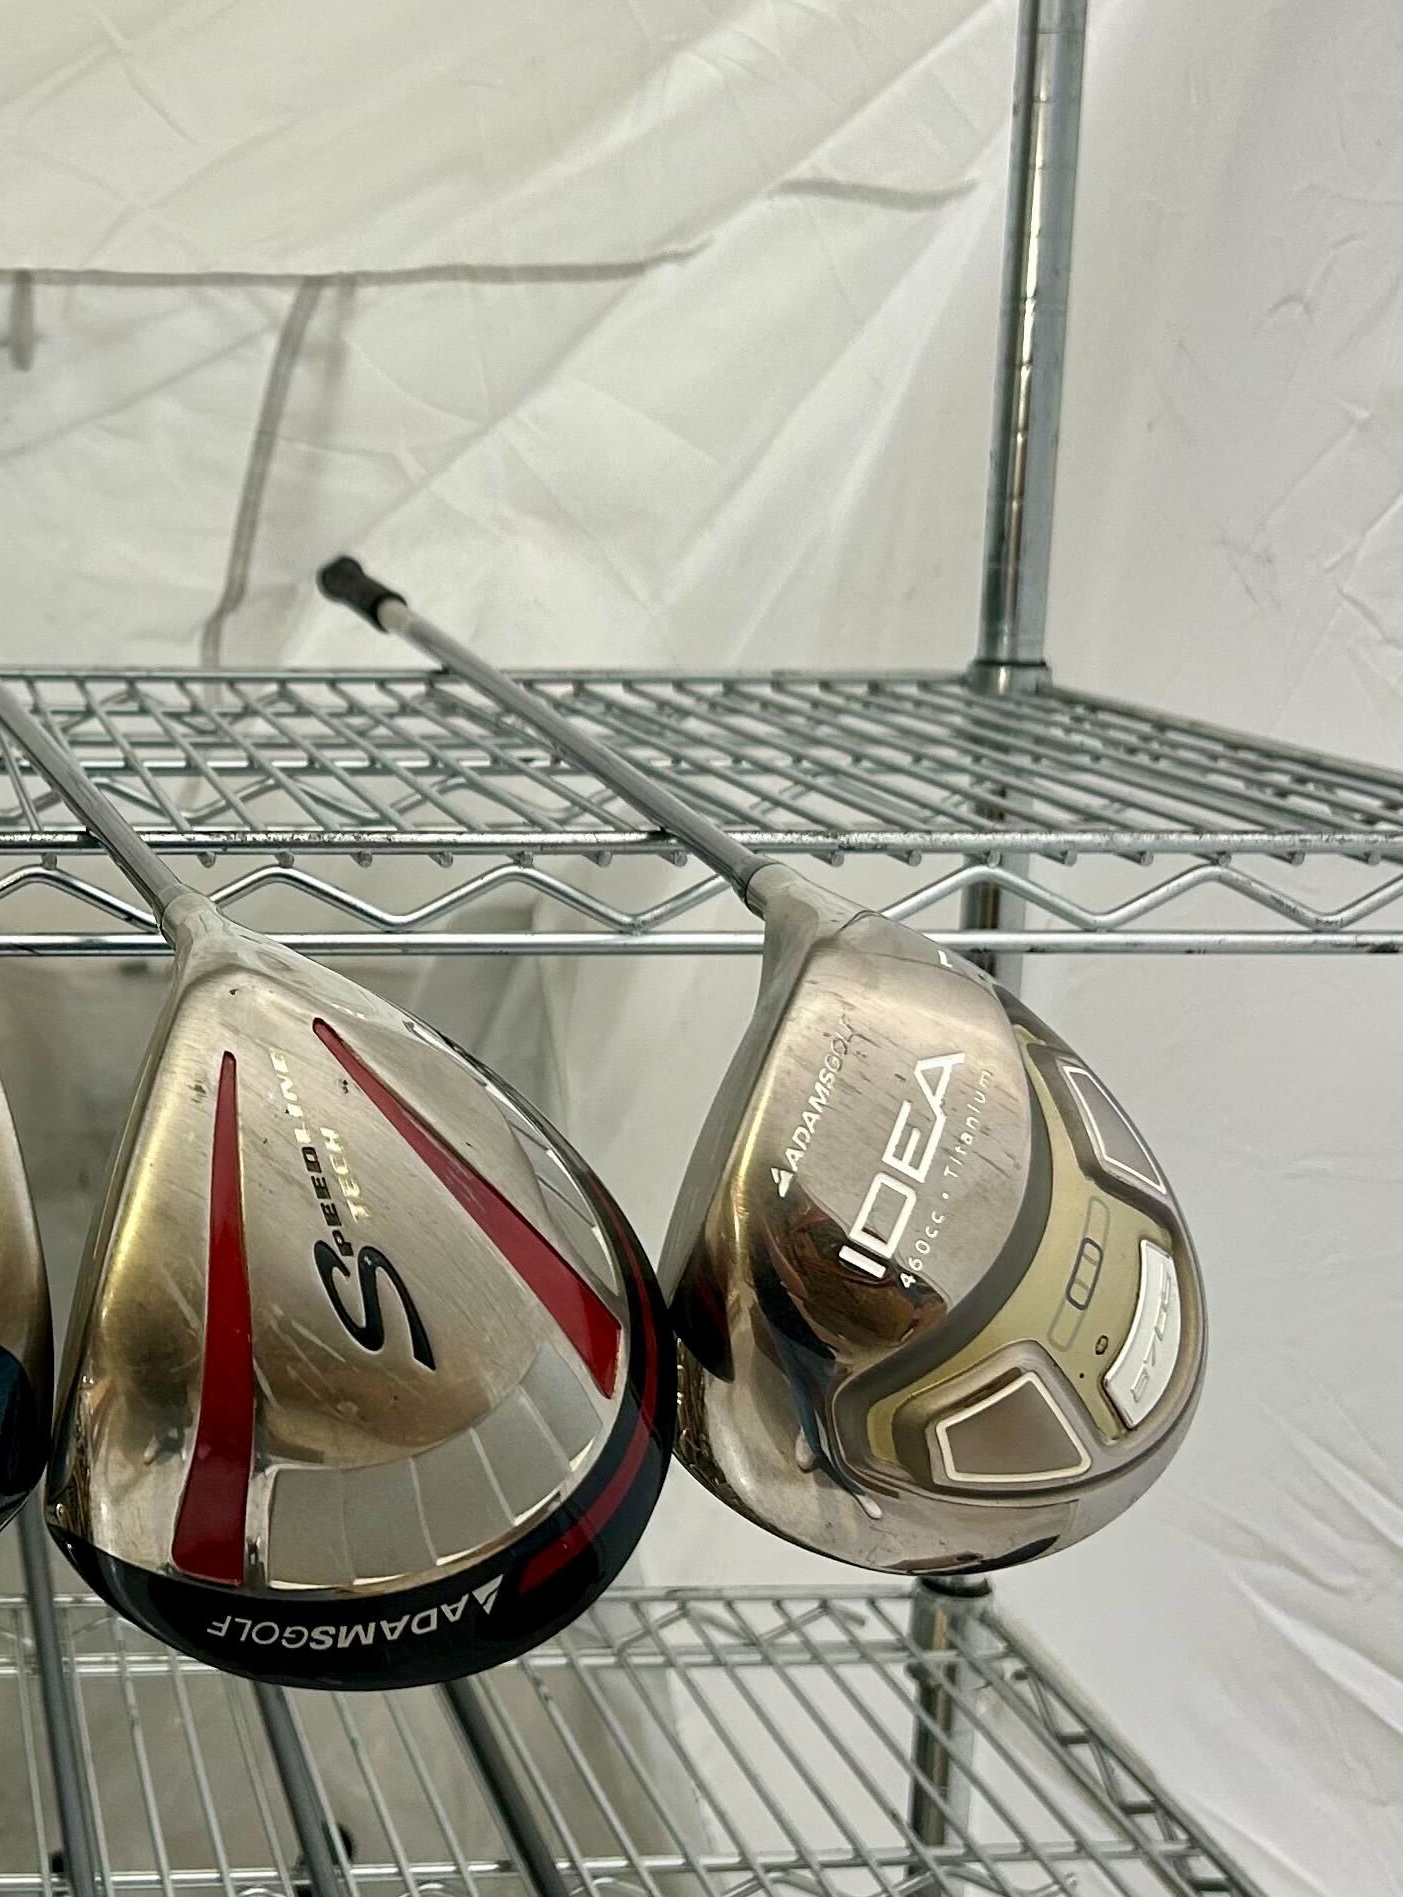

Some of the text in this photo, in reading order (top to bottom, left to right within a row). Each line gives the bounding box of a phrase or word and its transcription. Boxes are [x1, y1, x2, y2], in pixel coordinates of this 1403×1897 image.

[270, 1047, 436, 1371] SPEEDLINE
[318, 1126, 373, 1224] TECH
[838, 1051, 966, 1279] IDEA
[899, 1210, 946, 1289] 460cc
[207, 1591, 484, 1651] ADAMSGOLF
